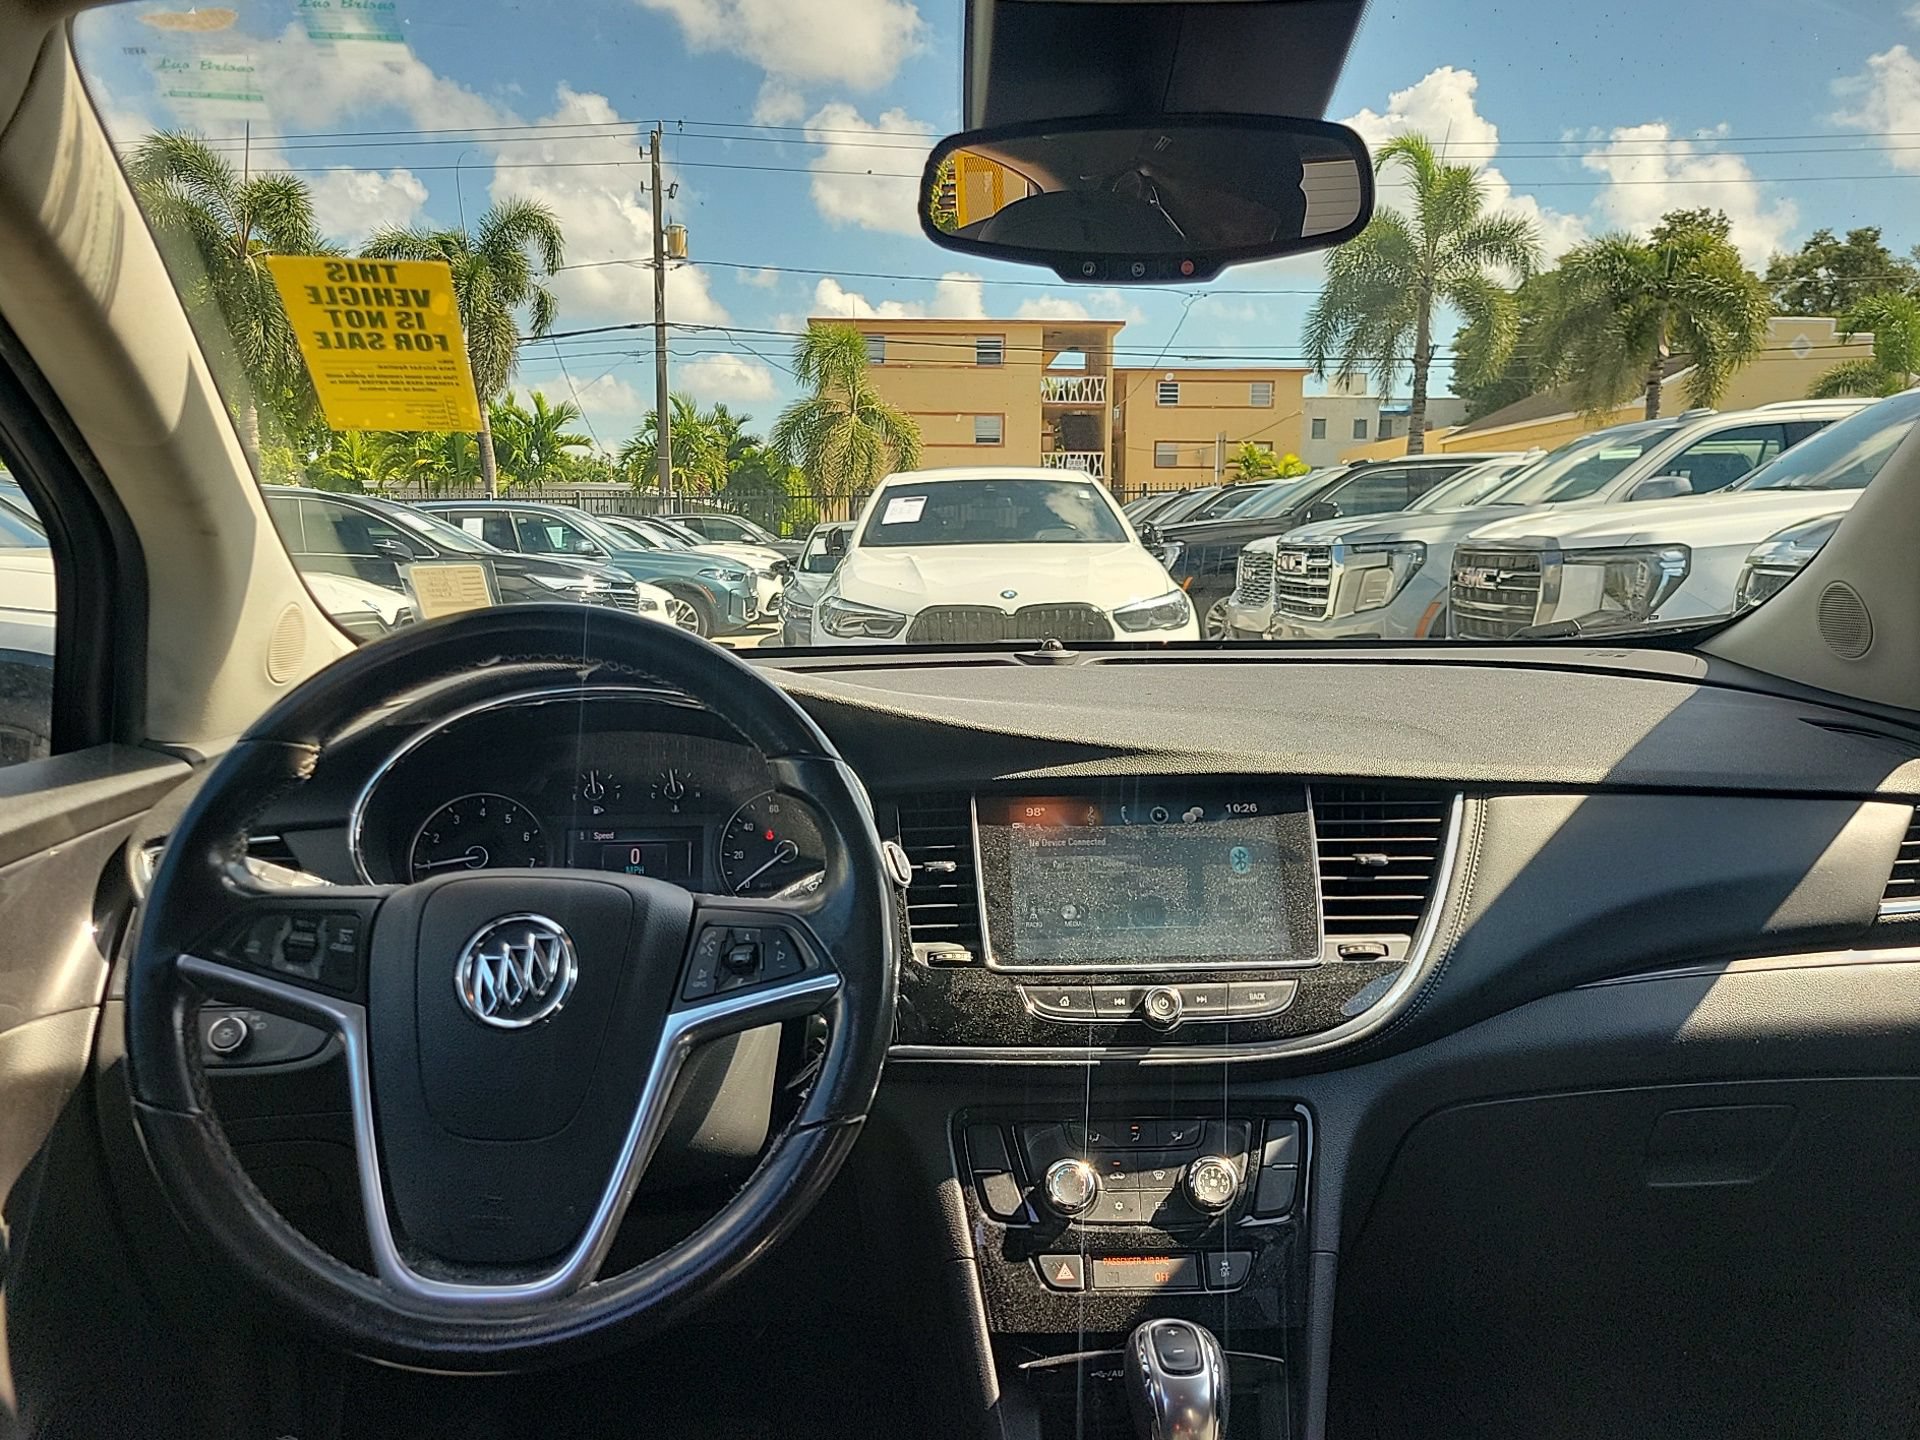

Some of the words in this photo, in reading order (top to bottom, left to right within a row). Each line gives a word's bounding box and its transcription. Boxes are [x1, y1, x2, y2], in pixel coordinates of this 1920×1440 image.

[479, 807, 486, 817] 4
[768, 804, 780, 813] 60
[1225, 803, 1258, 813] 10:26
[453, 814, 460, 825] 3
[505, 814, 512, 824] 5
[743, 823, 754, 832] 40
[433, 833, 440, 843] 2
[523, 832, 530, 842] 6
[593, 831, 615, 841] Speed
[1041, 838, 1066, 847] Device
[1067, 836, 1107, 847] Connected
[630, 847, 641, 865] 0
[733, 851, 744, 860] 20
[528, 857, 536, 869] 7
[625, 865, 645, 875] MPH
[1249, 992, 1266, 1001] BACK
[1102, 1256, 1143, 1266] PASSENGER
[1154, 1272, 1170, 1282] OFF
